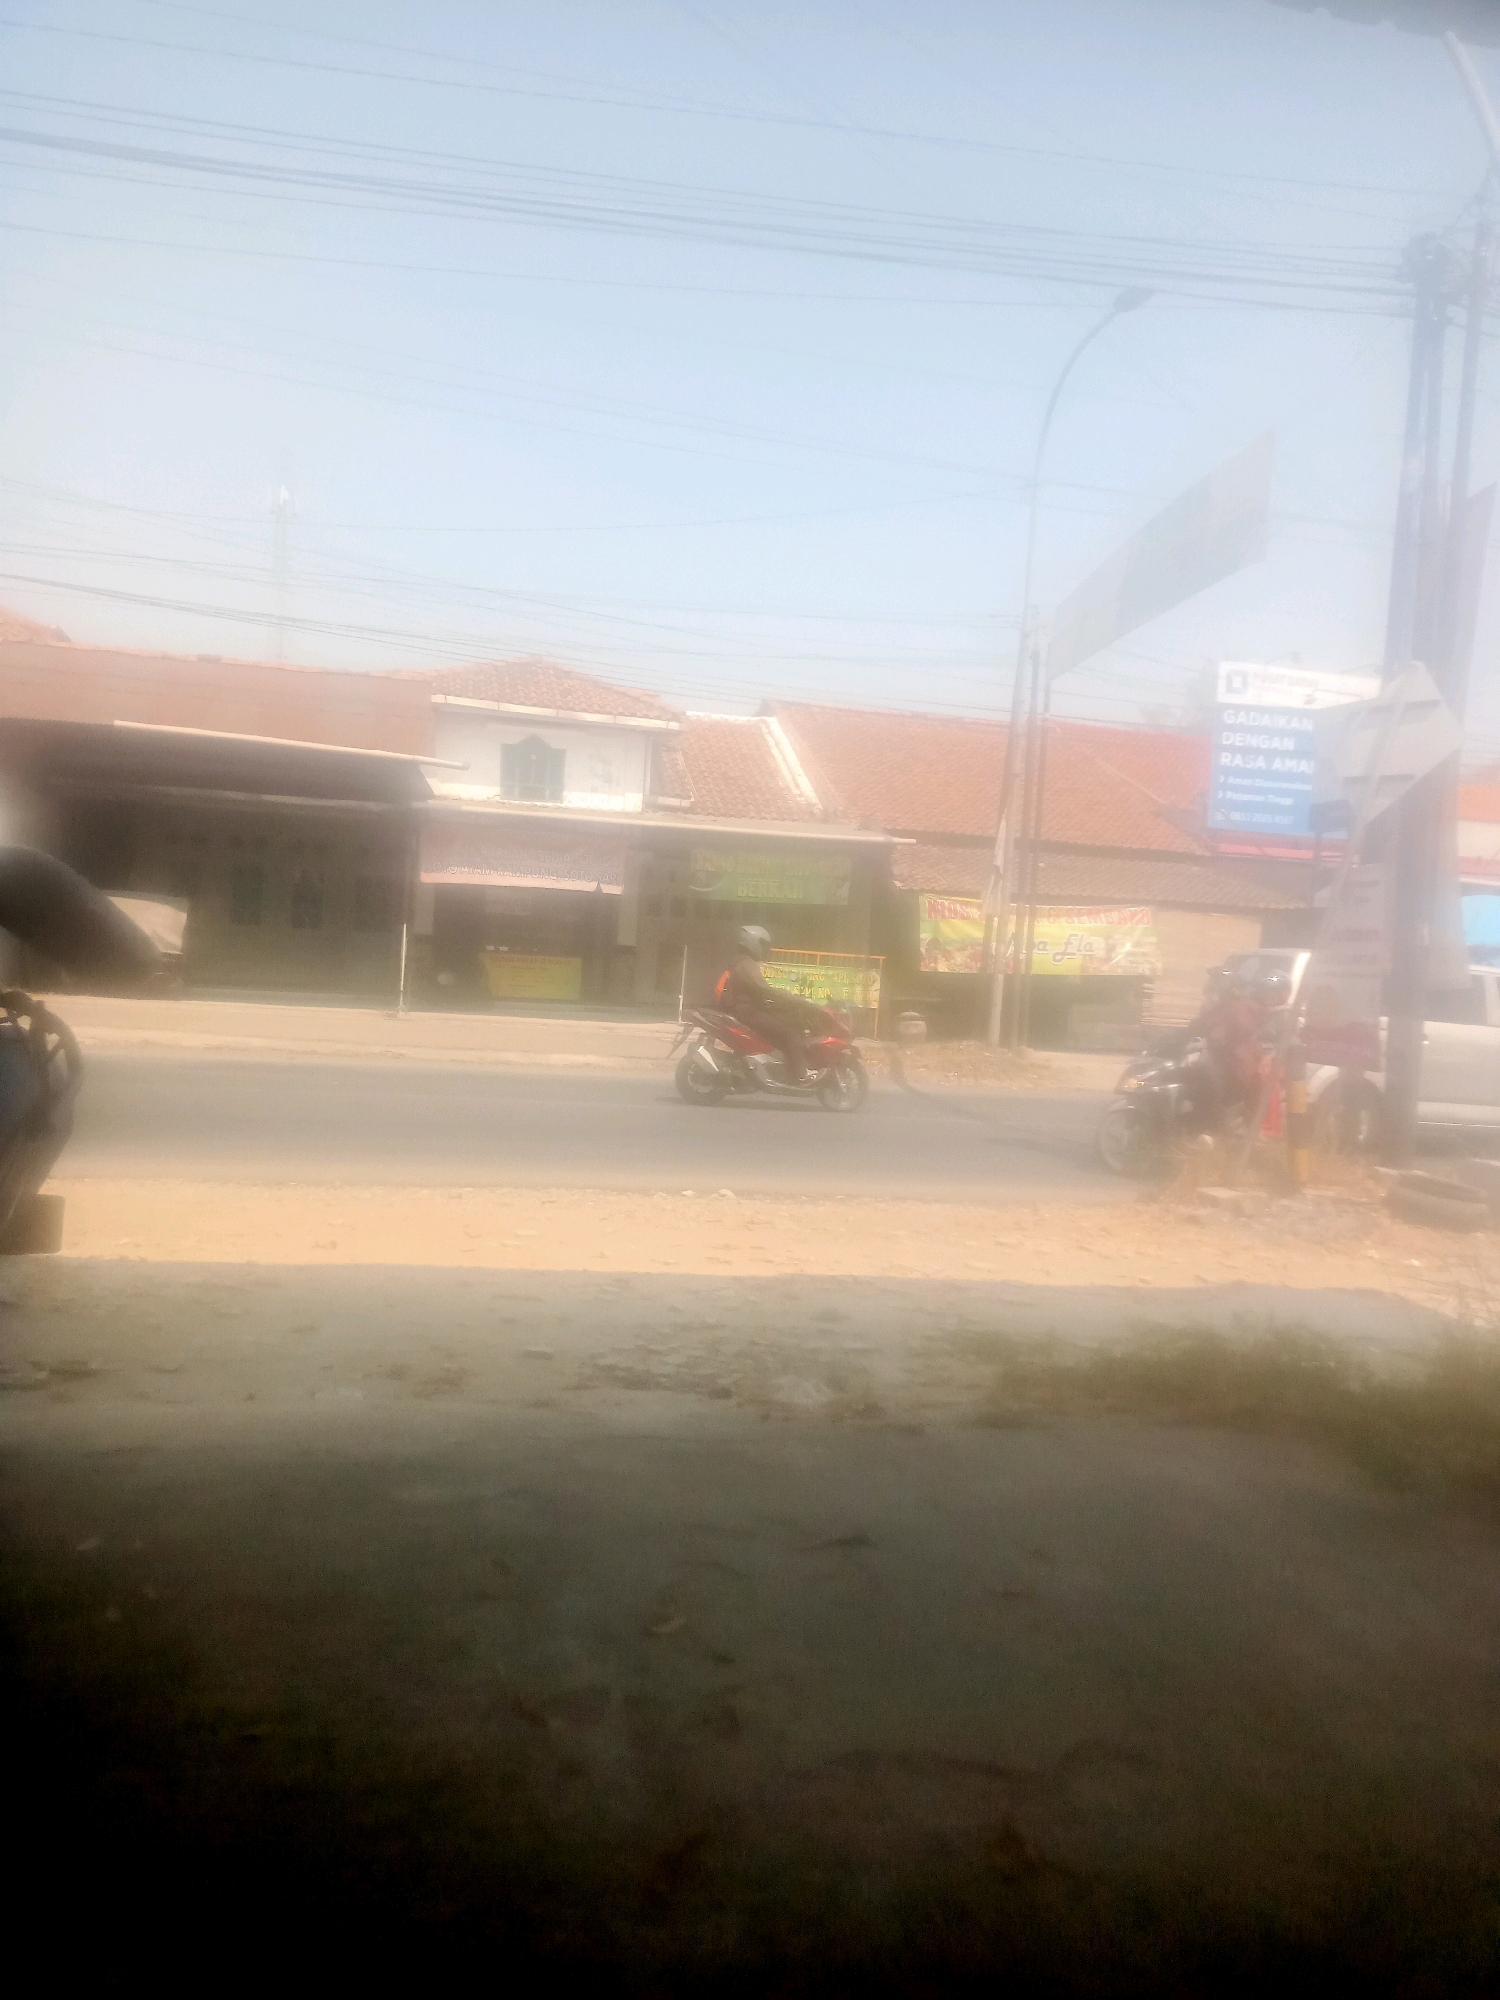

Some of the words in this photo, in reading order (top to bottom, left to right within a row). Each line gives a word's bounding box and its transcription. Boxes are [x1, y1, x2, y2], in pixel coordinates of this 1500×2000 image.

[1223, 710, 1314, 731] GADAIKAN
[1221, 732, 1296, 751] DENGAN
[1219, 752, 1267, 770] RASA
[562, 869, 593, 882] SOTO
[736, 879, 804, 899] BERKAH
